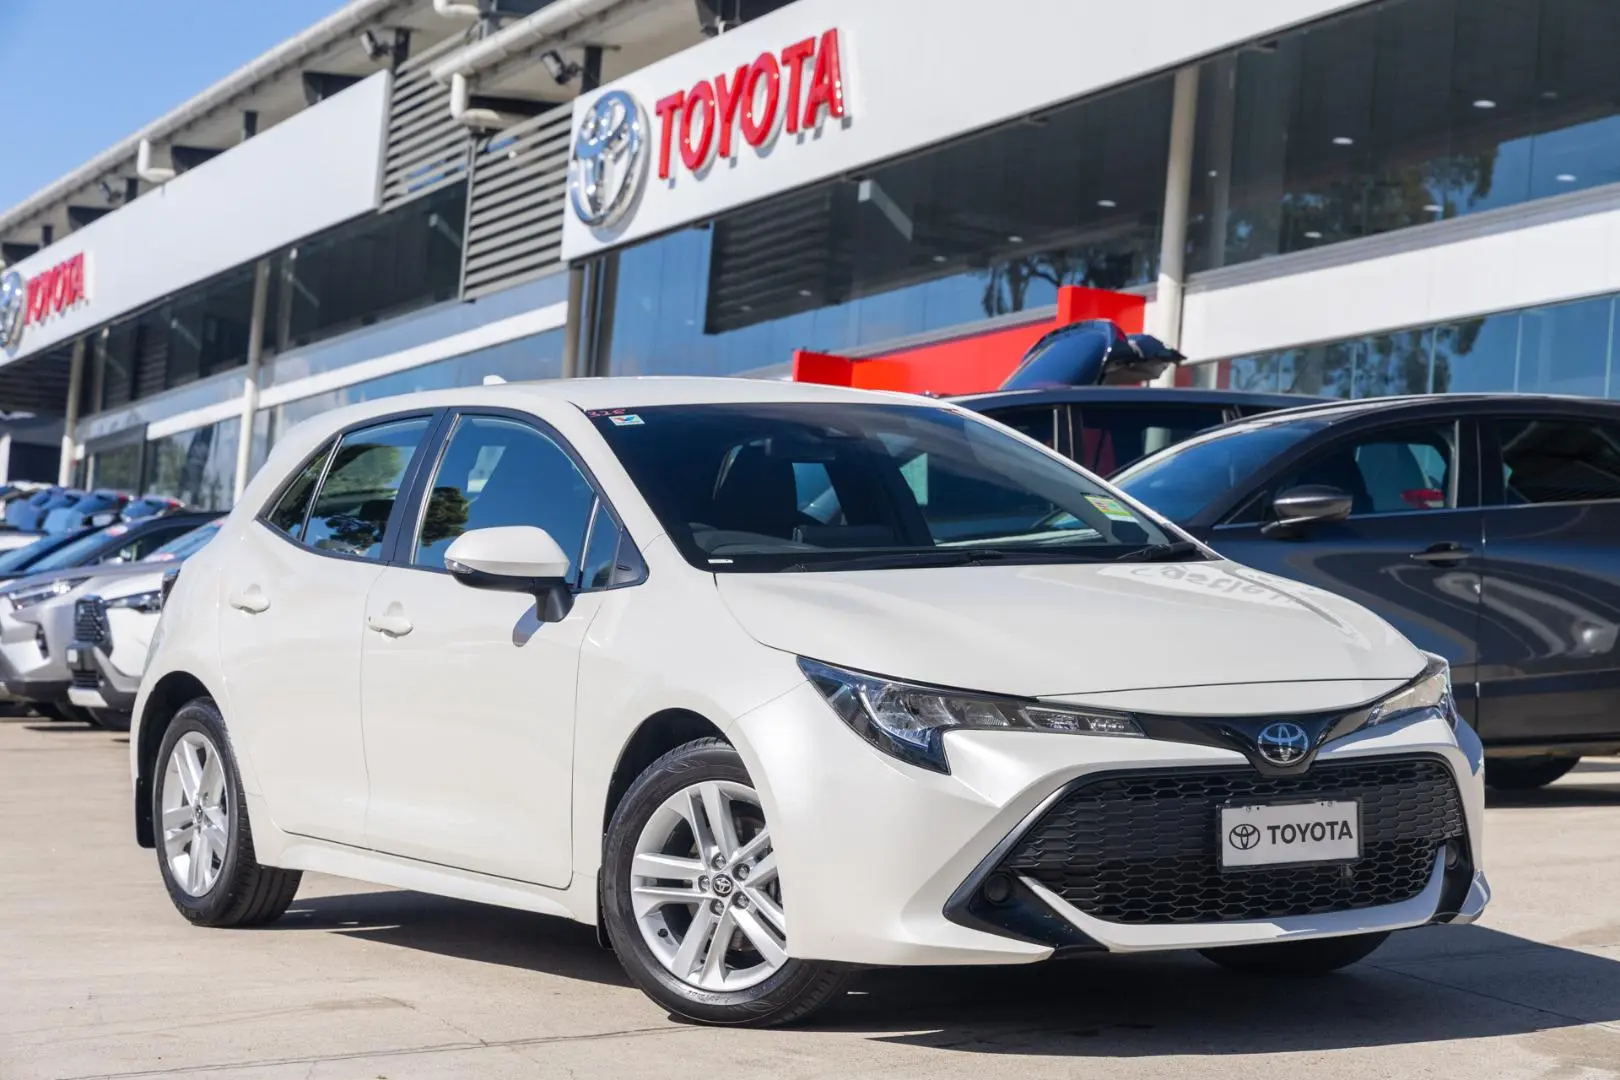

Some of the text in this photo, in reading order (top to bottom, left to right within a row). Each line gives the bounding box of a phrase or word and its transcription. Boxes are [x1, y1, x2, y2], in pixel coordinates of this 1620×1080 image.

[656, 27, 844, 180] TOYOTA
[24, 252, 84, 326] TOYOTA
[1267, 820, 1353, 845] TOYOTA
